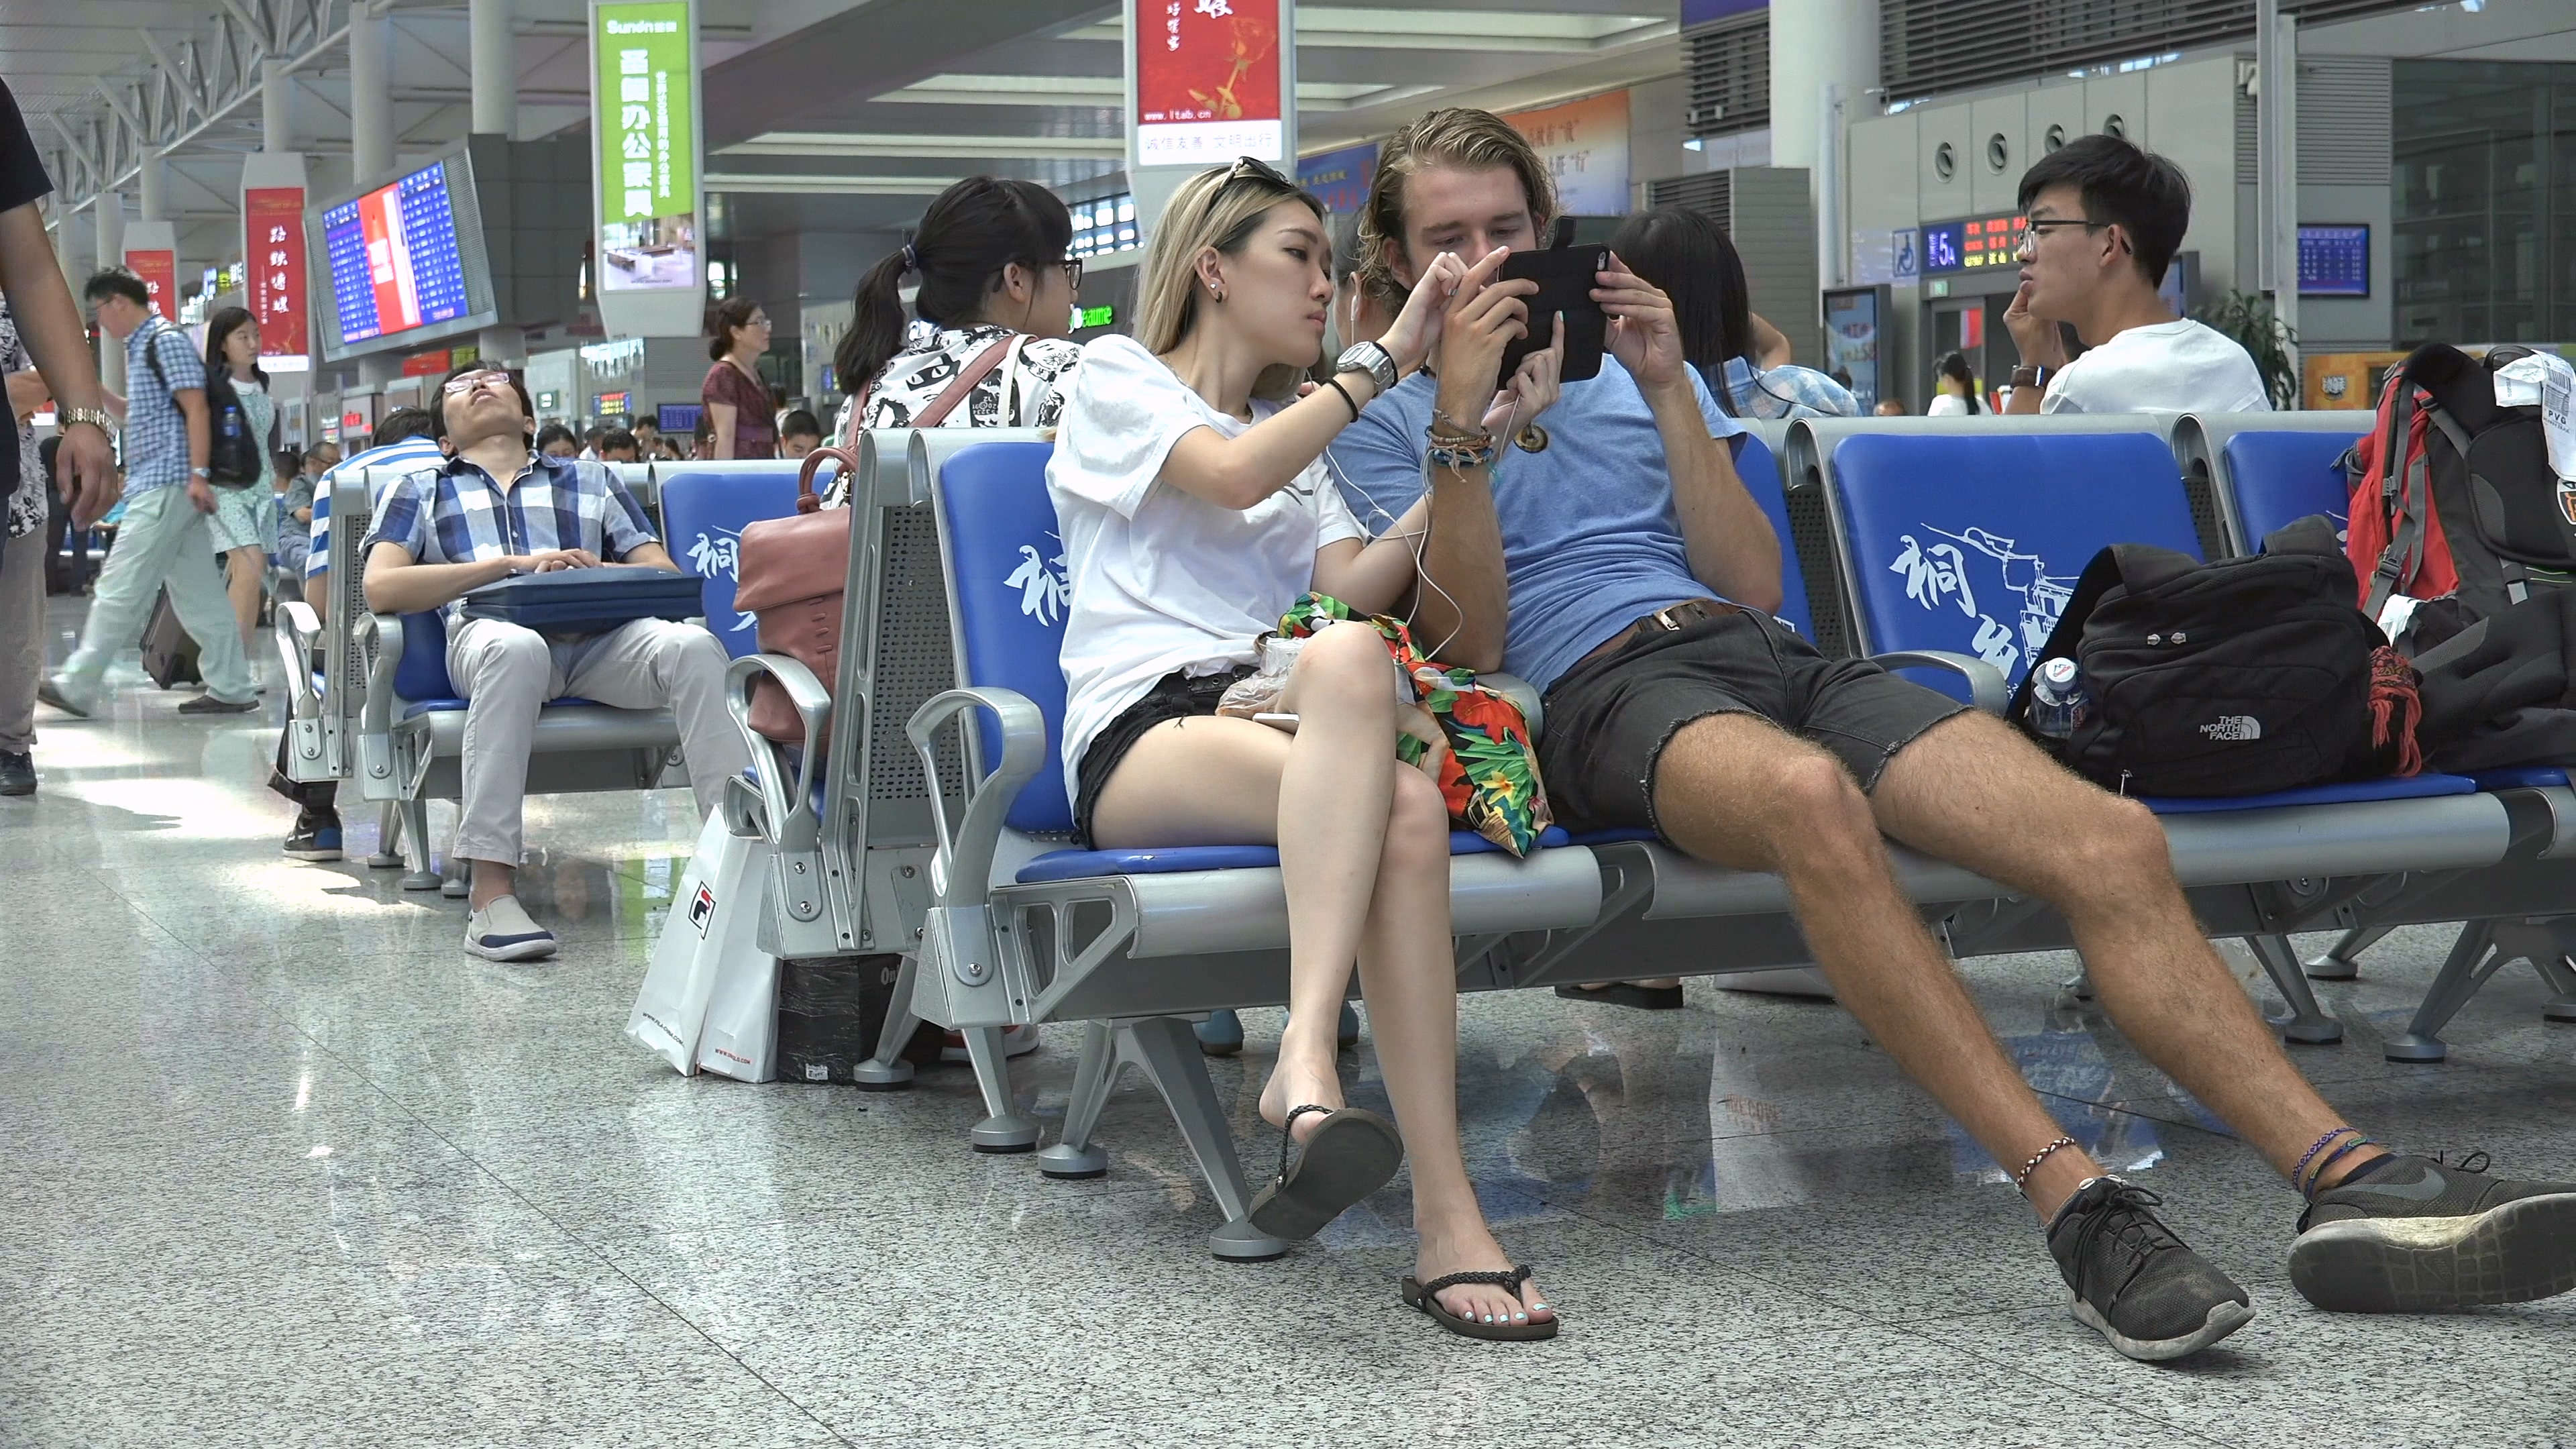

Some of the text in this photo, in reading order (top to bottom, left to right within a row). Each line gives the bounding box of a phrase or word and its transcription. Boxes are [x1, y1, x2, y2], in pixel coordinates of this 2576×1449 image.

[2548, 409, 2567, 425] PVG
[2218, 716, 2242, 724] THE
[2200, 723, 2241, 733] NORTH
[2209, 731, 2241, 741] FACE
